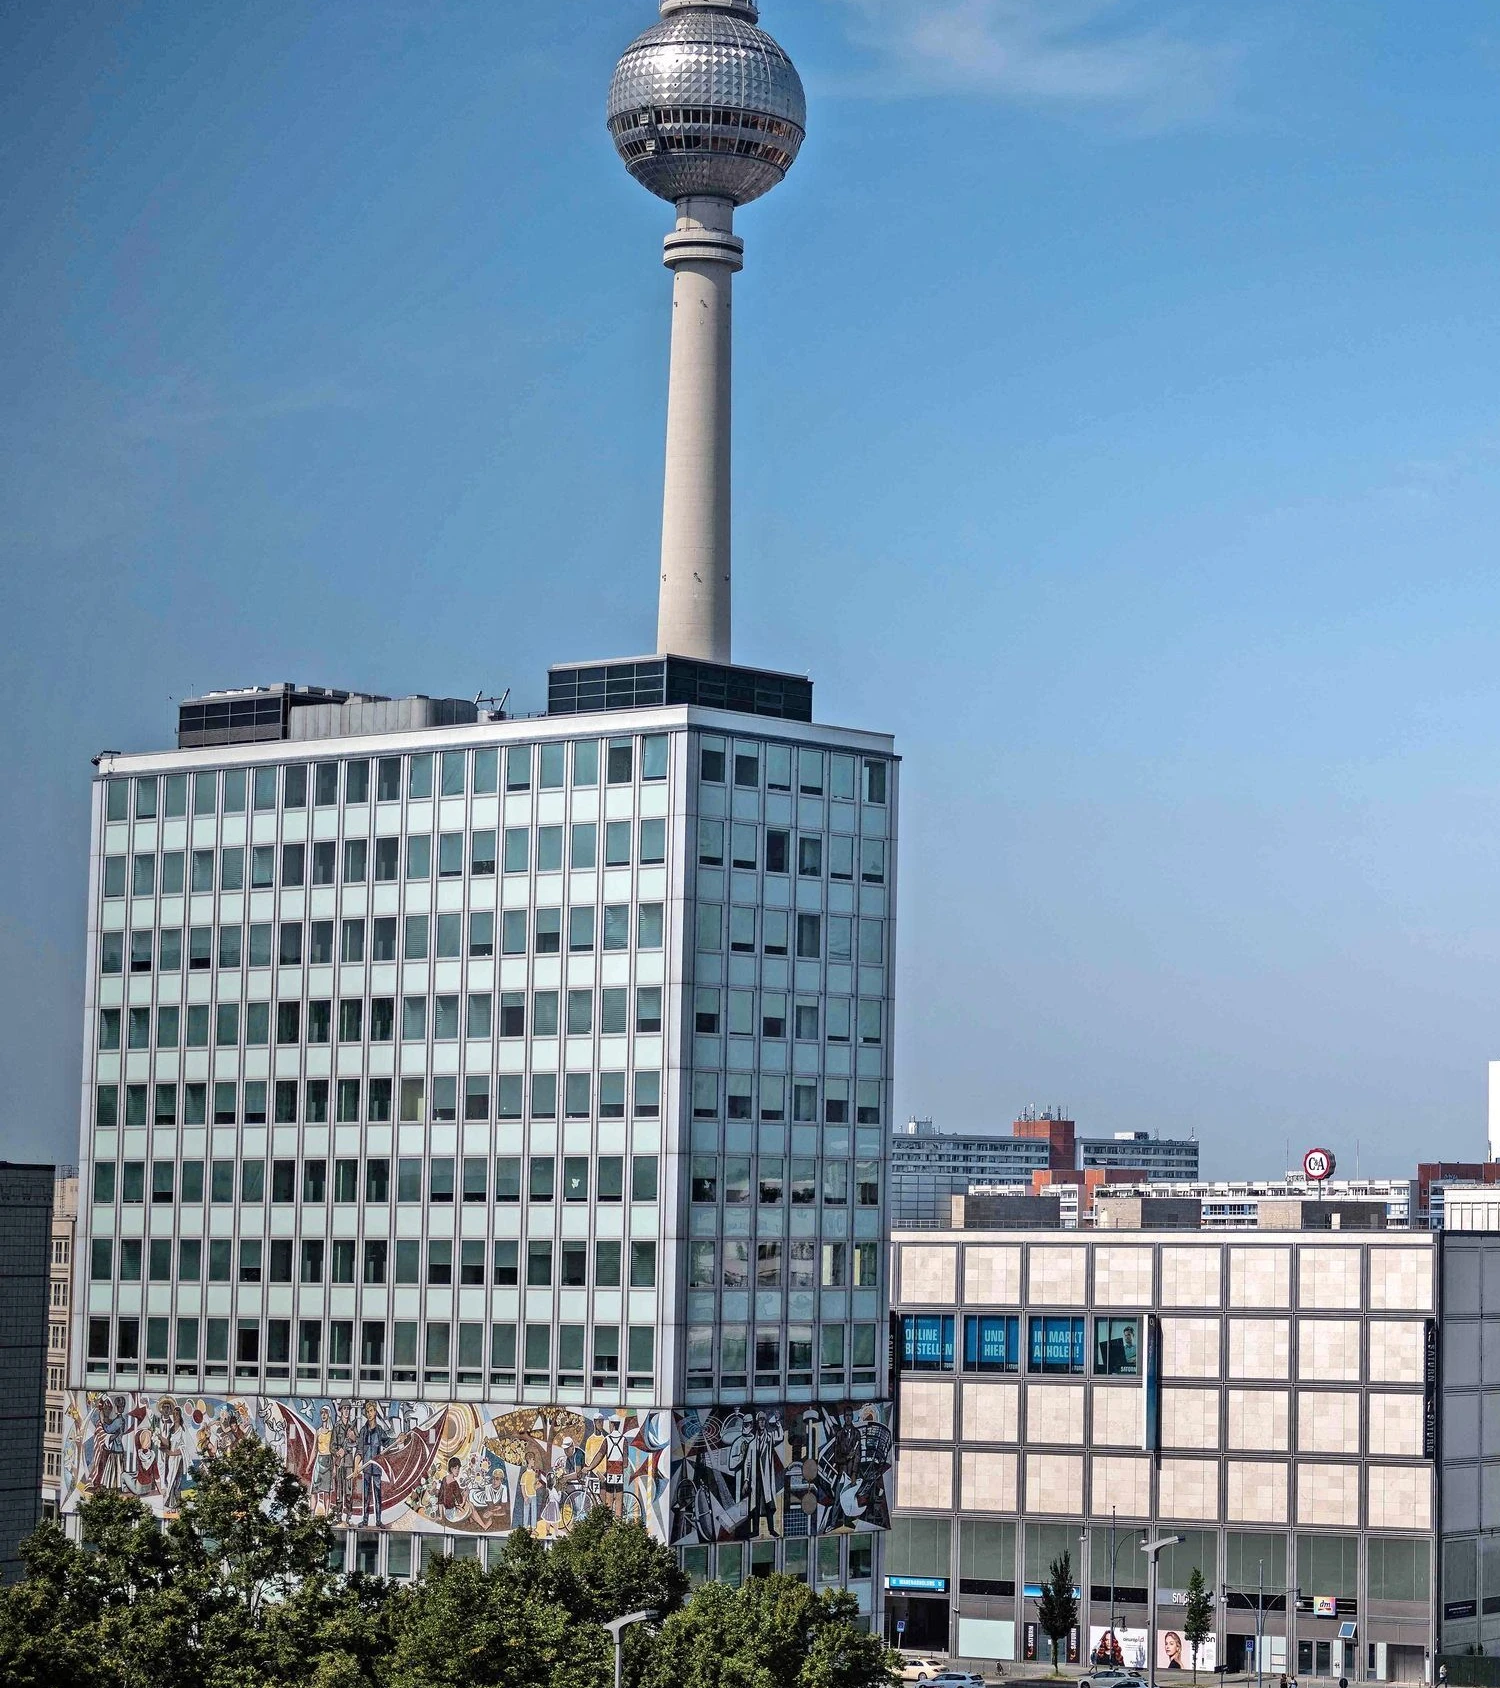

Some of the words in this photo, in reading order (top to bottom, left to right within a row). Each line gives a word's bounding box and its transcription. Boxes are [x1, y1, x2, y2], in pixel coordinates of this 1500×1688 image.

[1308, 1156, 1326, 1171] C&A
[984, 1329, 1004, 1342] UND
[984, 1344, 1005, 1357] HIER
[1427, 1343, 1436, 1382] SATURN
[1426, 1413, 1435, 1452] SATURN
[1319, 1599, 1331, 1608] dm
